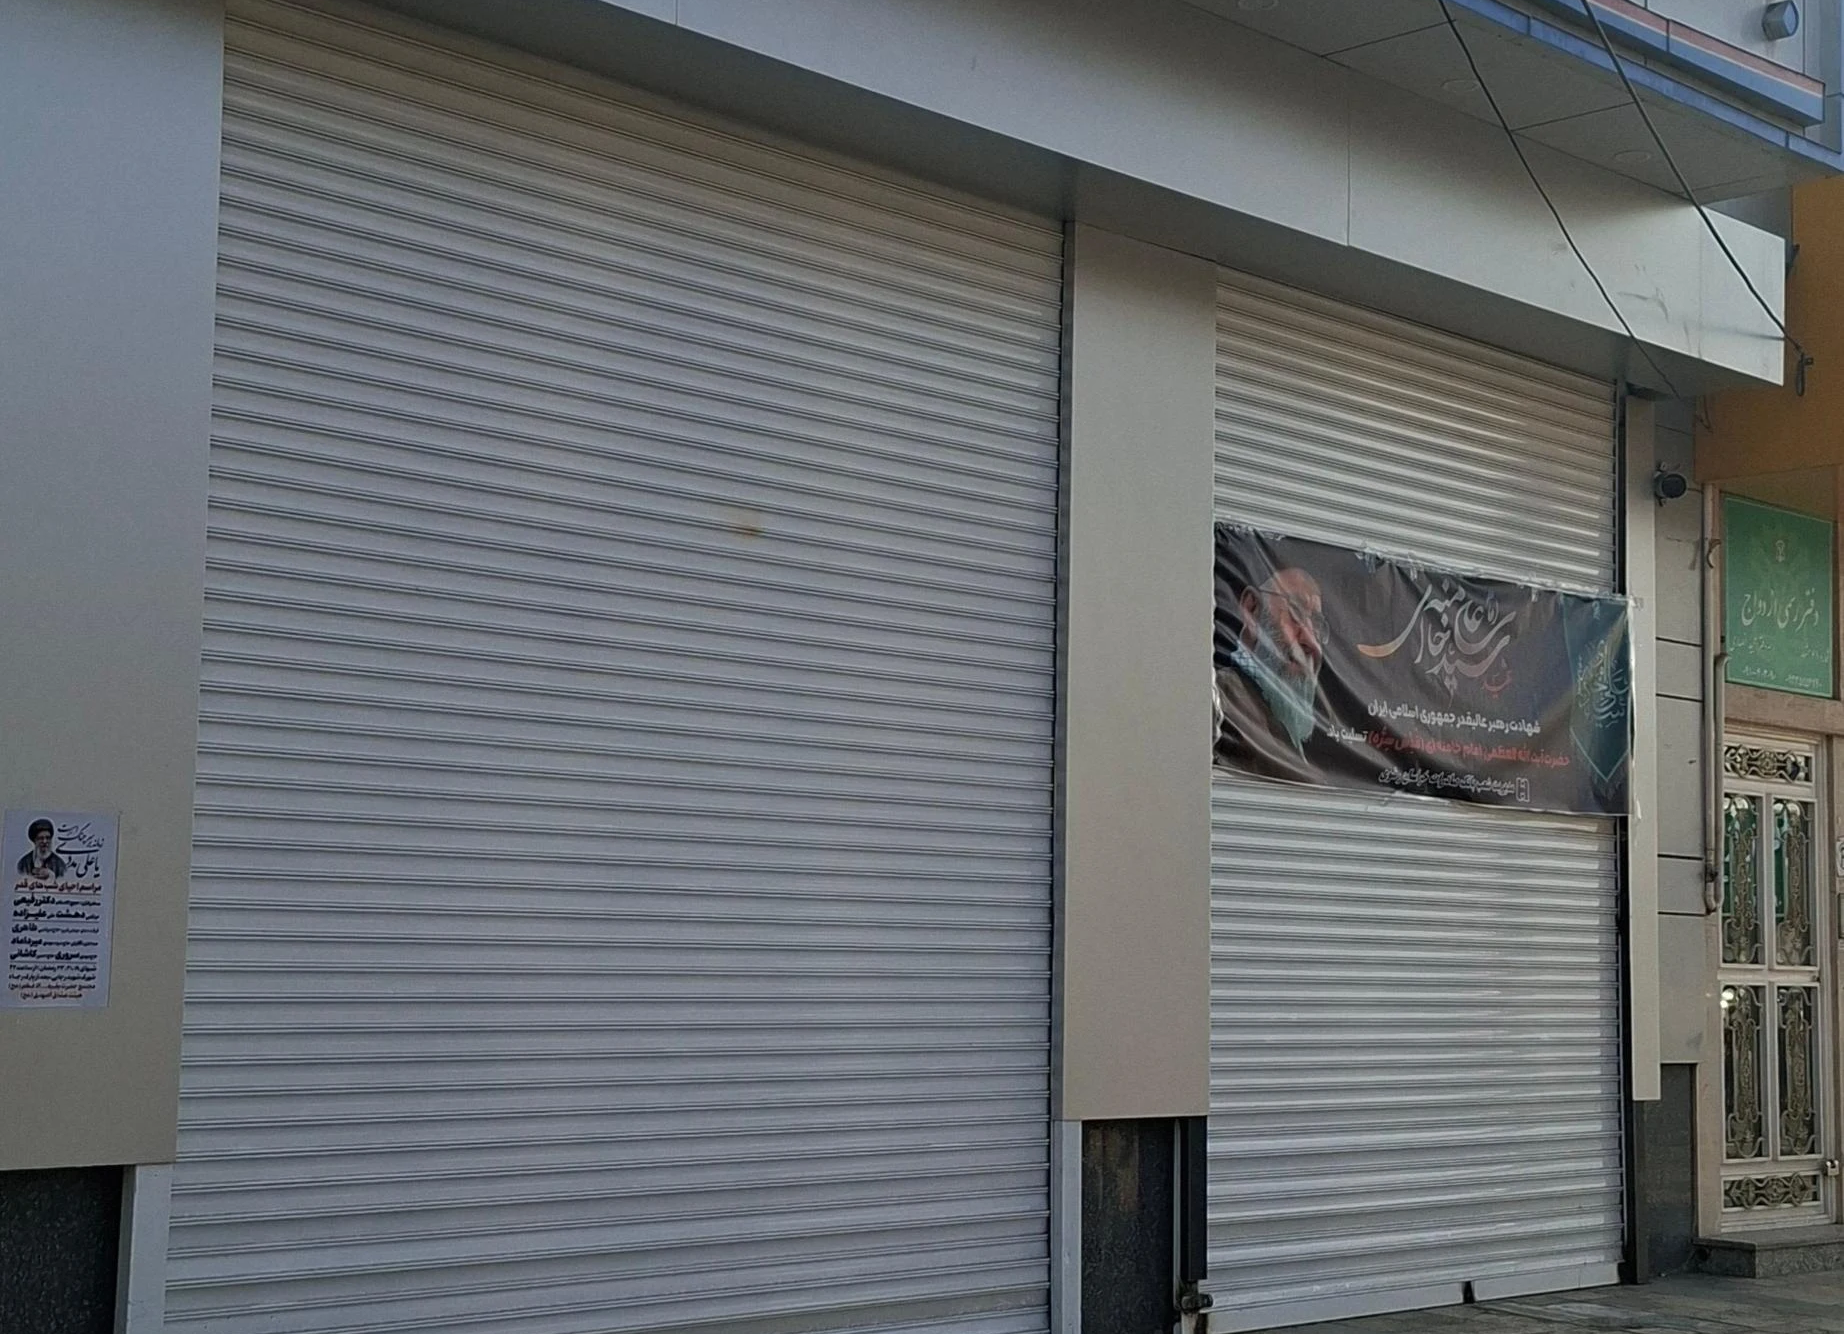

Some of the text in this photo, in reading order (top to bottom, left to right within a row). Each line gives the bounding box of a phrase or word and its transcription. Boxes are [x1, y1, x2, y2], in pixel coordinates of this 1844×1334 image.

[1741, 589, 1777, 627] ازدواج
[1368, 699, 1541, 737] شهادت رهبر عالیقدر جمهوری اسلامی ایران
[1341, 727, 1368, 744] تسلیت
[14, 878, 28, 890] قدر
[79, 882, 102, 892] مراسم
